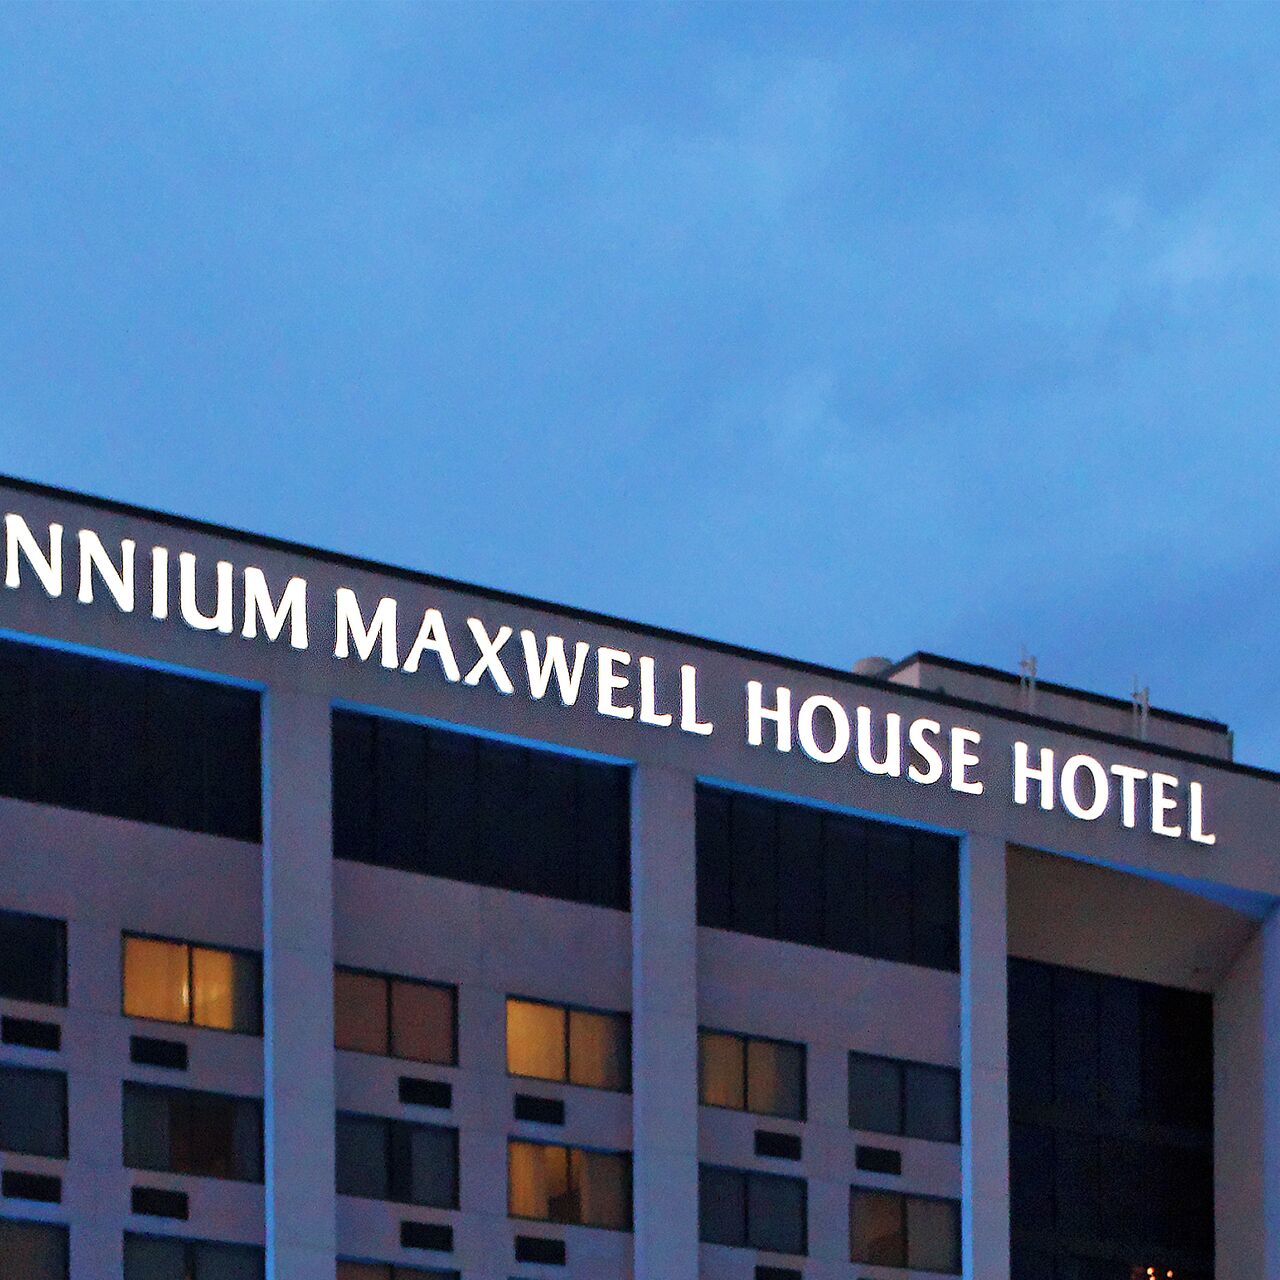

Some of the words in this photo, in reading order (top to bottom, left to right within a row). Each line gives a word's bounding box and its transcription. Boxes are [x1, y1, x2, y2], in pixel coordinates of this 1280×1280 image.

[333, 587, 714, 736] MAXWELL
[746, 680, 984, 795] HOUSE
[1014, 741, 1216, 845] HOTEL
